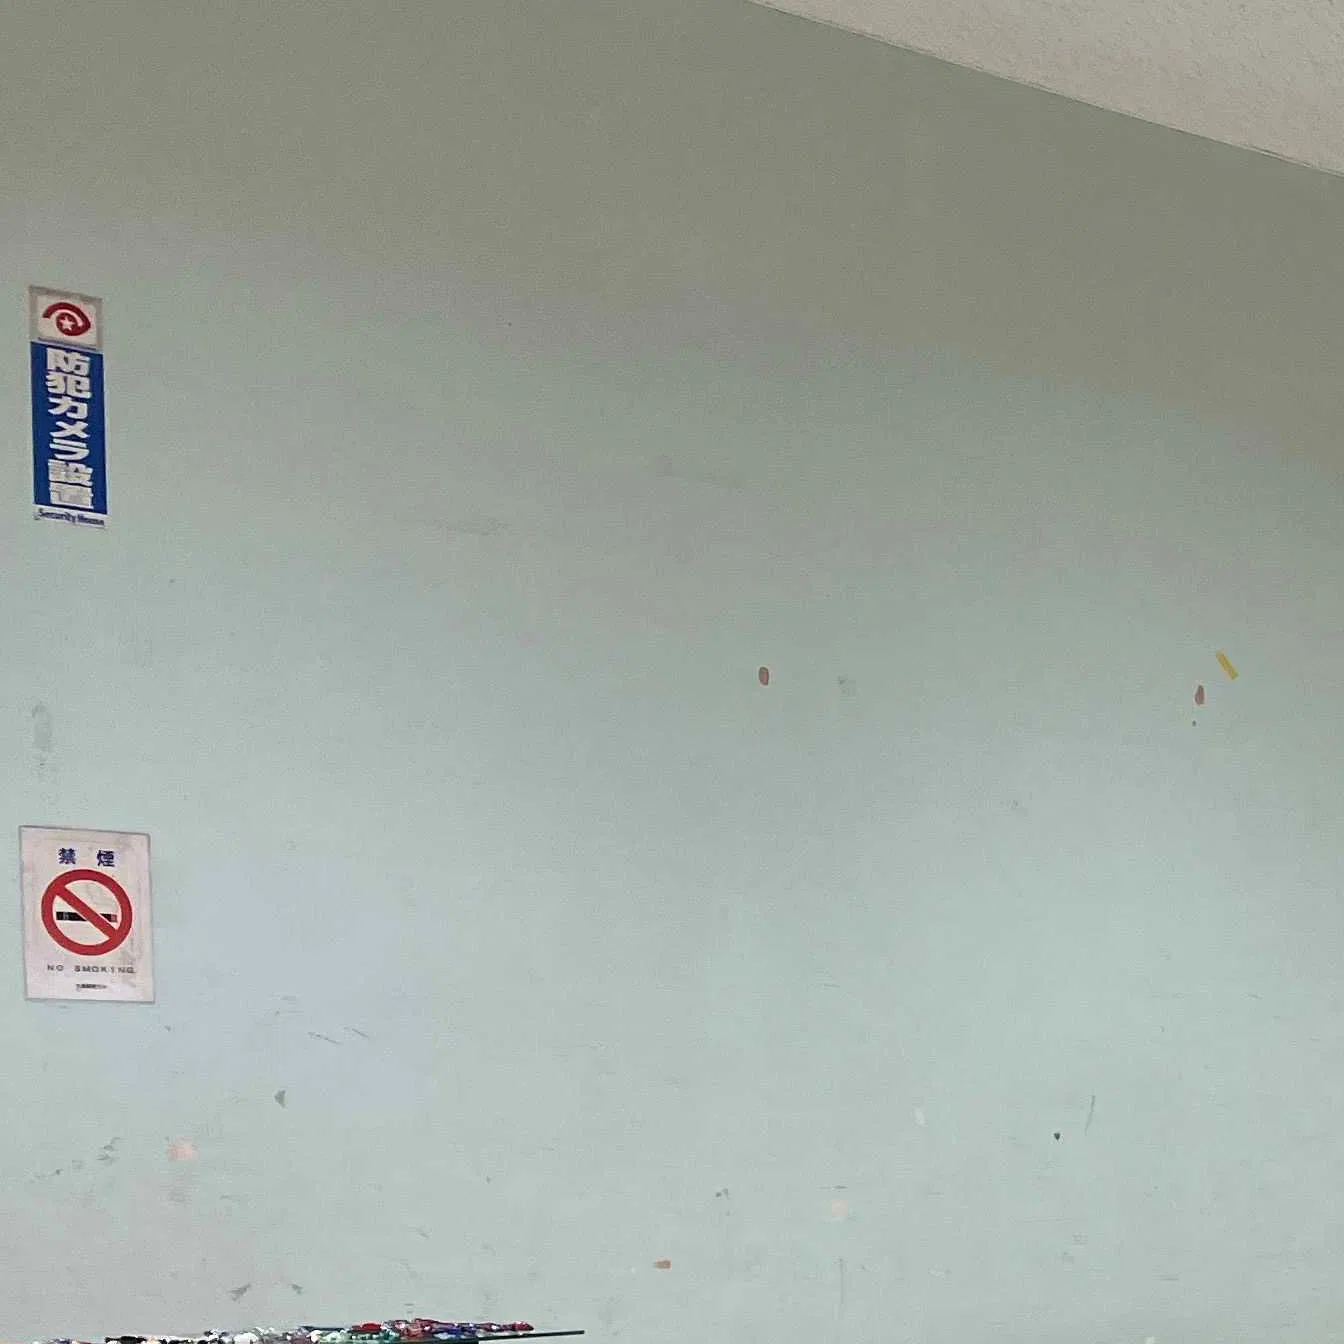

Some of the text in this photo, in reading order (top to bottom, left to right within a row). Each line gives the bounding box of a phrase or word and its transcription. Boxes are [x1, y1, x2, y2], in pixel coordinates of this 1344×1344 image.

[45, 347, 95, 510] 防犯カメラ設置
[58, 847, 115, 868] 禁煙
[47, 964, 136, 974] NO SMOKING
